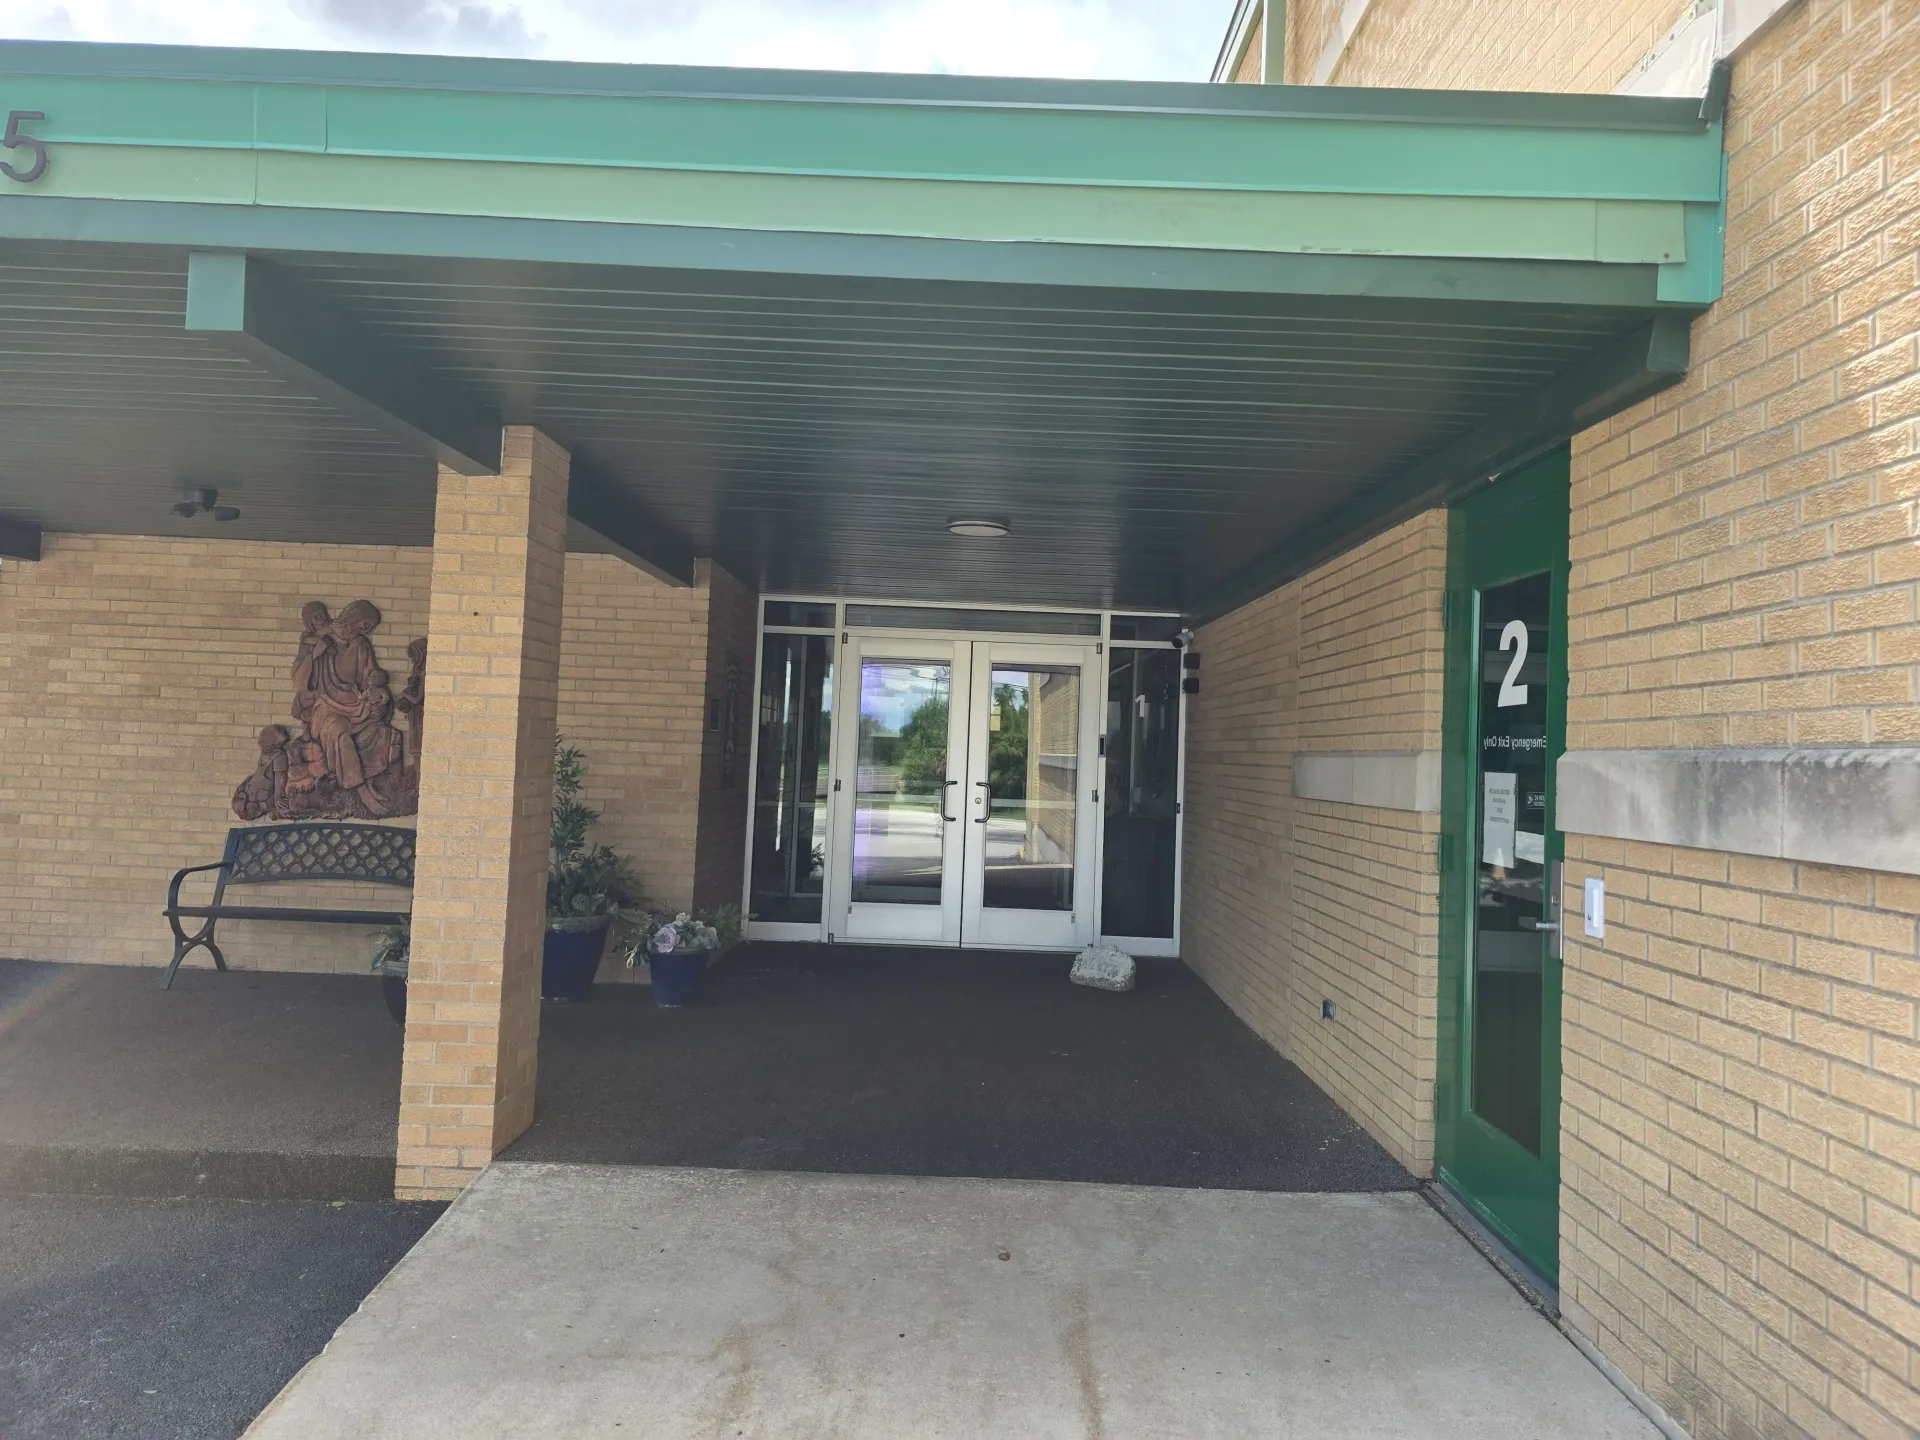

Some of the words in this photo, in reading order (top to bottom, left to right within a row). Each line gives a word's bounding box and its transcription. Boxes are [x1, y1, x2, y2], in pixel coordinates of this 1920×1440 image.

[0, 110, 46, 182] 5
[1498, 620, 1528, 707] 2
[1134, 694, 1146, 718] 1
